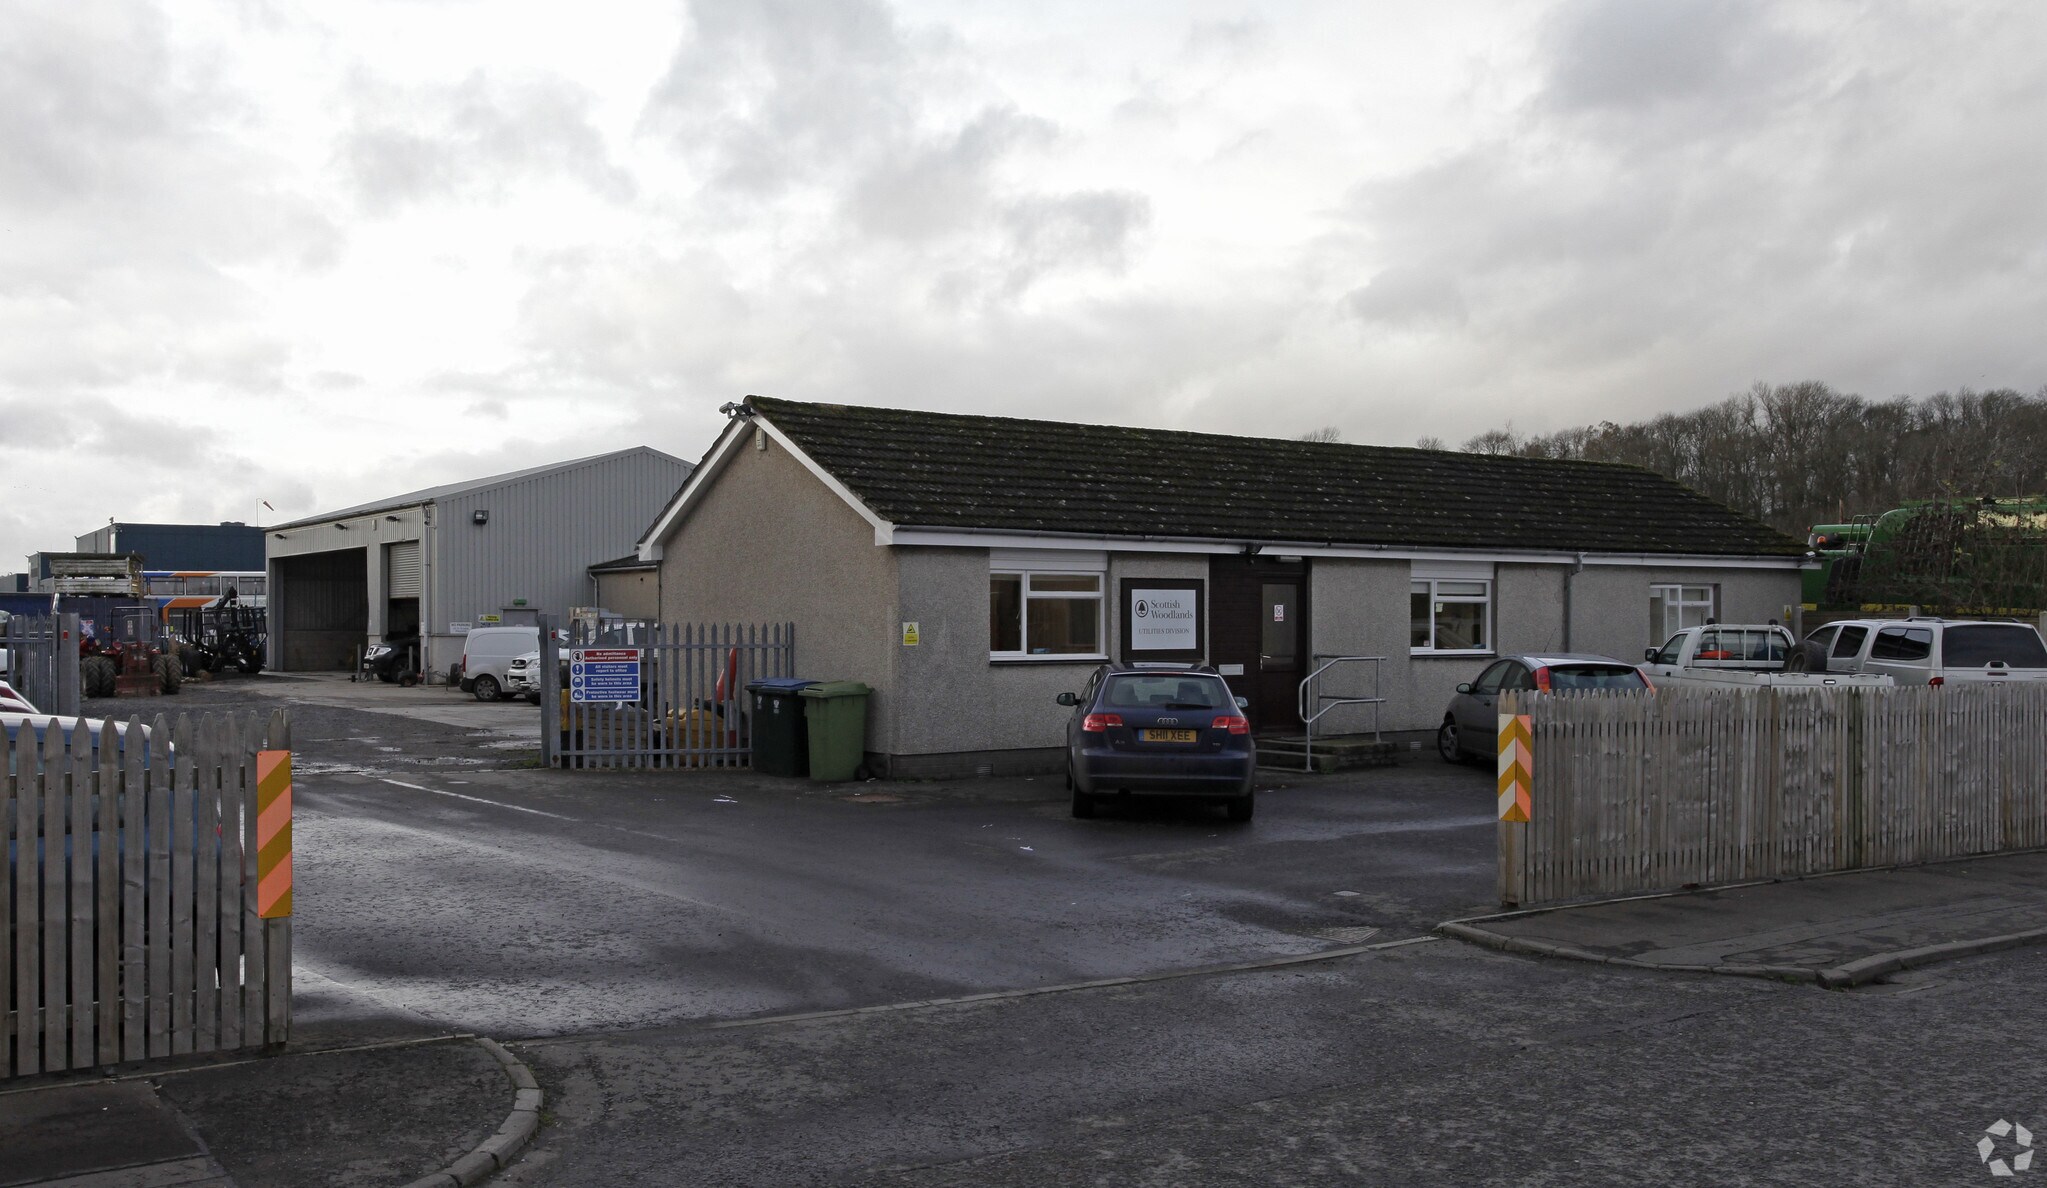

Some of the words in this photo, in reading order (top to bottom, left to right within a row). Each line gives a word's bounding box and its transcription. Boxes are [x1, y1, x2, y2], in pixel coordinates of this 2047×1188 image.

[1151, 600, 1180, 609] Scottish
[1151, 610, 1193, 619] Woodlands
[1149, 730, 1168, 739] SH11
[1170, 730, 1191, 740] XEE
